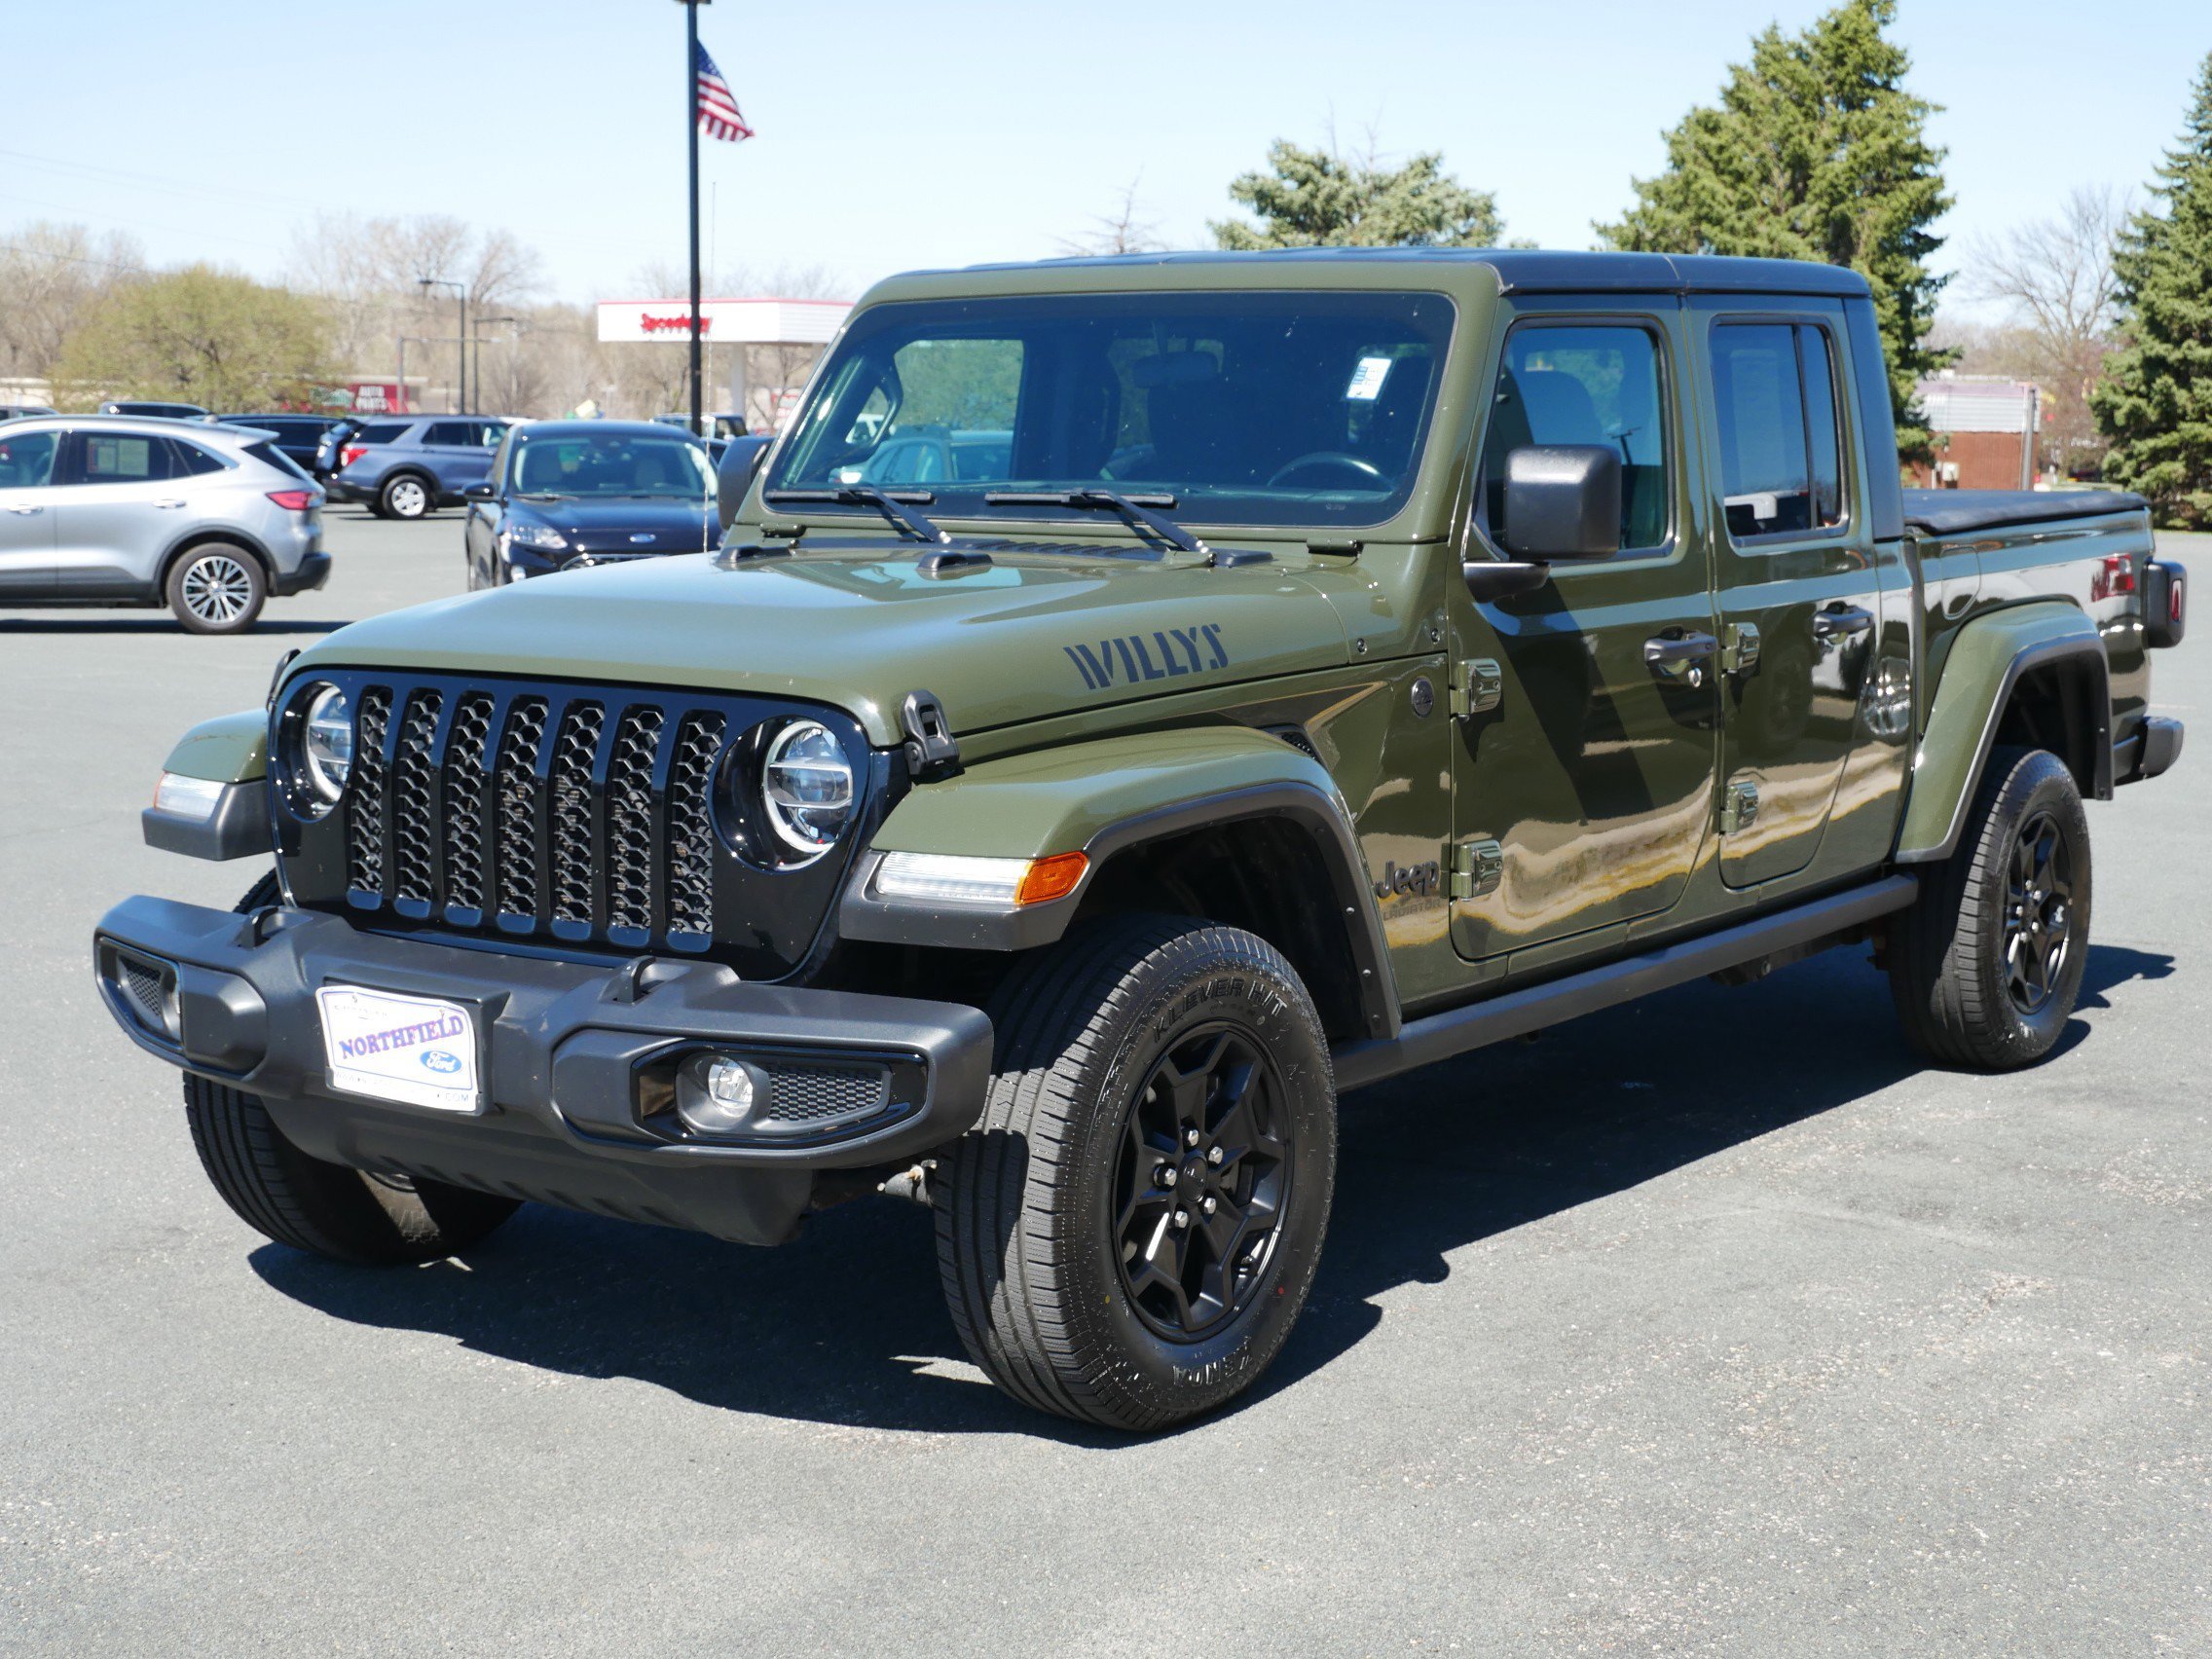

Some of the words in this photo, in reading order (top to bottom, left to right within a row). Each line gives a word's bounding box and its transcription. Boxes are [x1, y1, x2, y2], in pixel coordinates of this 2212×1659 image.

[1063, 623, 1229, 690] WILLYS
[1376, 861, 1439, 898] Jeep
[1153, 977, 1245, 1043] KLEVER
[339, 1015, 464, 1059] NORTHFIELD
[425, 1051, 458, 1073] Ford
